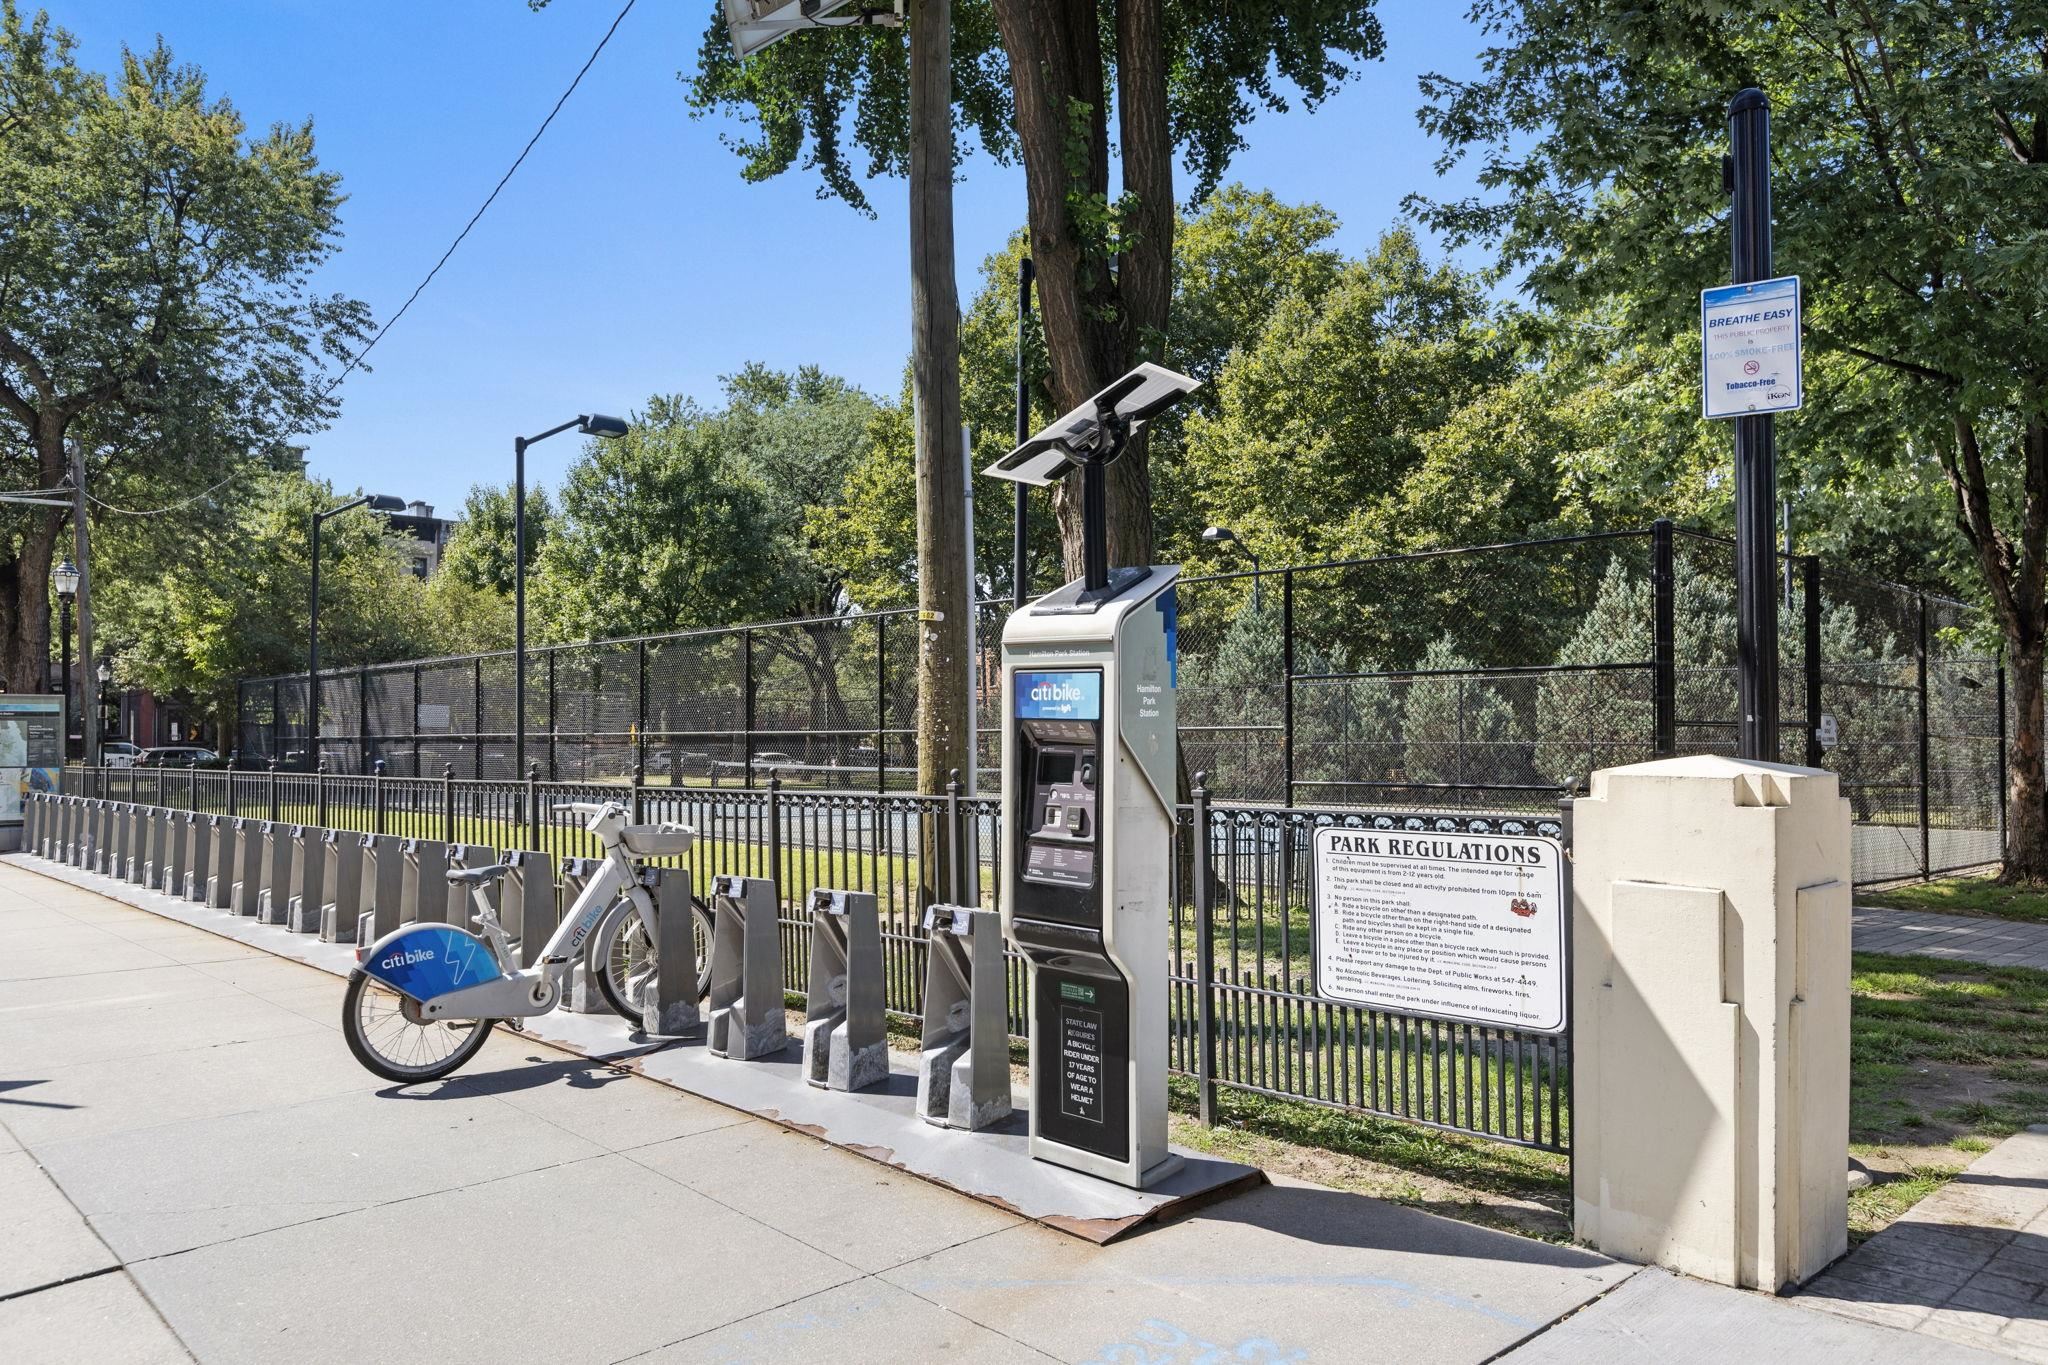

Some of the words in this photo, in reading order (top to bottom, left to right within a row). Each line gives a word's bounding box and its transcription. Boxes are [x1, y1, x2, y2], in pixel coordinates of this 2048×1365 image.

[1709, 313, 1760, 328] BREATHE
[1764, 308, 1793, 320] EASY
[1714, 333, 1728, 341] THIS
[1730, 330, 1754, 338] PUBLIC
[1756, 325, 1791, 336] PROPERTY
[1734, 342, 1795, 357] SMOKE-FREE
[1726, 378, 1776, 390] Tobacco-Free
[1069, 648, 1090, 656] Station
[1136, 684, 1161, 693] Hamilton
[1142, 696, 1156, 705] Park
[1140, 708, 1159, 717] Station
[1330, 836, 1380, 854] PARK
[1388, 839, 1541, 864] REGULATIONS
[1349, 867, 1381, 875] equipment
[1460, 867, 1489, 875] intended
[1514, 870, 1534, 879] usage
[1423, 884, 1446, 892] activity
[1447, 886, 1480, 894] prohibited
[1359, 904, 1381, 912] bicycle
[1426, 910, 1461, 919] designated
[1360, 911, 1381, 919] bicycle
[1433, 918, 1466, 928] right-hand
[1495, 925, 1532, 934] designated
[1367, 919, 1392, 927] bicycles
[1415, 924, 1430, 932] kept
[1425, 940, 1439, 948] than
[1444, 942, 1465, 951] bicycle
[1342, 938, 1360, 946] Leave
[1365, 941, 1386, 949] bicycle
[1393, 945, 1405, 953] any
[1431, 949, 1456, 957] position
[1457, 952, 1477, 960] which
[1500, 957, 1519, 965] cause
[1520, 959, 1547, 968] persons
[1397, 952, 1420, 961] injured
[1335, 956, 1354, 964] Please
[1384, 962, 1408, 971] damage
[1452, 970, 1472, 979] Public
[1473, 973, 1492, 982] Works
[1344, 968, 1370, 977] Alcoholic
[1432, 979, 1462, 990] Soliciting
[1379, 992, 1395, 1001] enter
[1395, 993, 1405, 1001] the
[1440, 1000, 1470, 1010] influence
[1478, 1005, 1518, 1018] intoxicating
[1066, 1018, 1082, 1028] STATE
[1084, 1021, 1097, 1030] LAW
[1072, 1040, 1096, 1051] BICYCLE
[1064, 1049, 1080, 1059] RIDER
[1081, 1054, 1100, 1064] UNDER
[1076, 1063, 1094, 1072] YEARS
[1076, 1074, 1087, 1082] AGE
[1070, 1082, 1088, 1093] WEAR
[1070, 1093, 1093, 1104] HELMET
